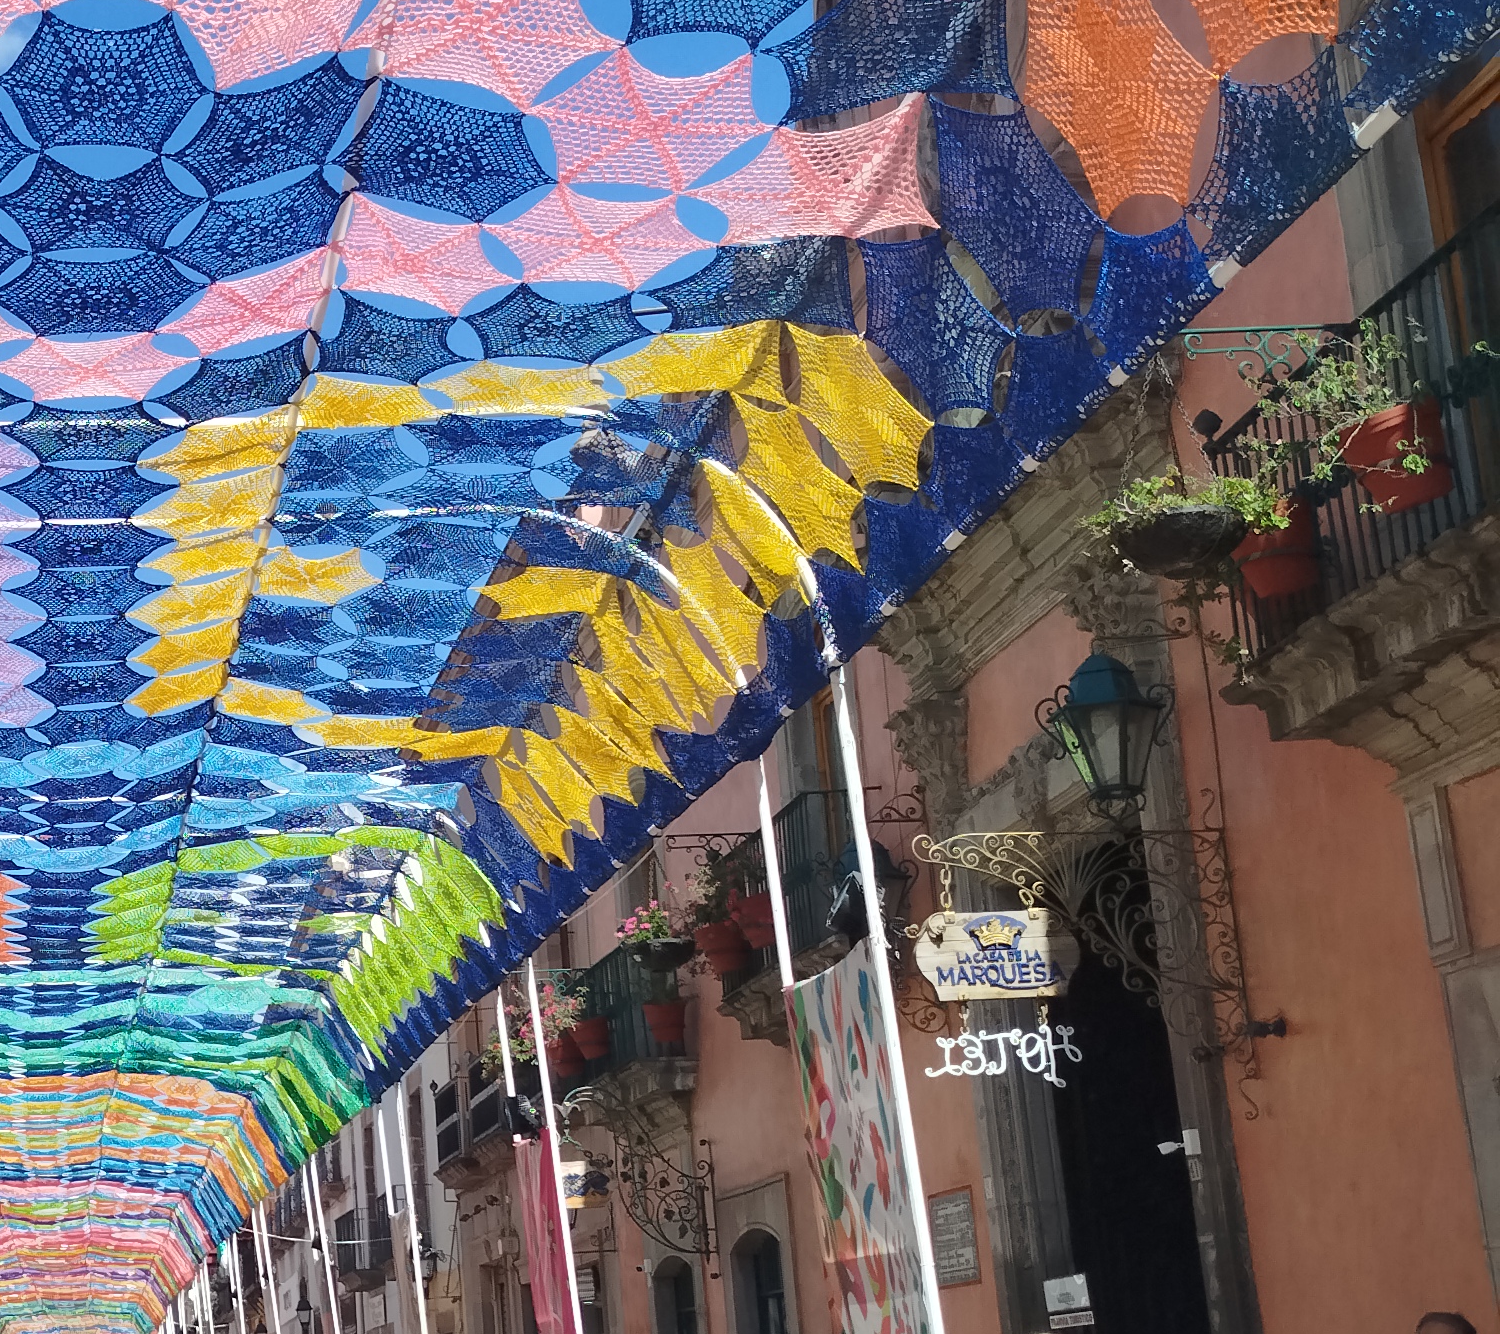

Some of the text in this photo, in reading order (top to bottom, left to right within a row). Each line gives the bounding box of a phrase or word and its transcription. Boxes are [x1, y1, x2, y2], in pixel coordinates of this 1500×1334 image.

[955, 949, 1042, 964] LA CASA DE LA
[936, 961, 1067, 990] MARQUESA
